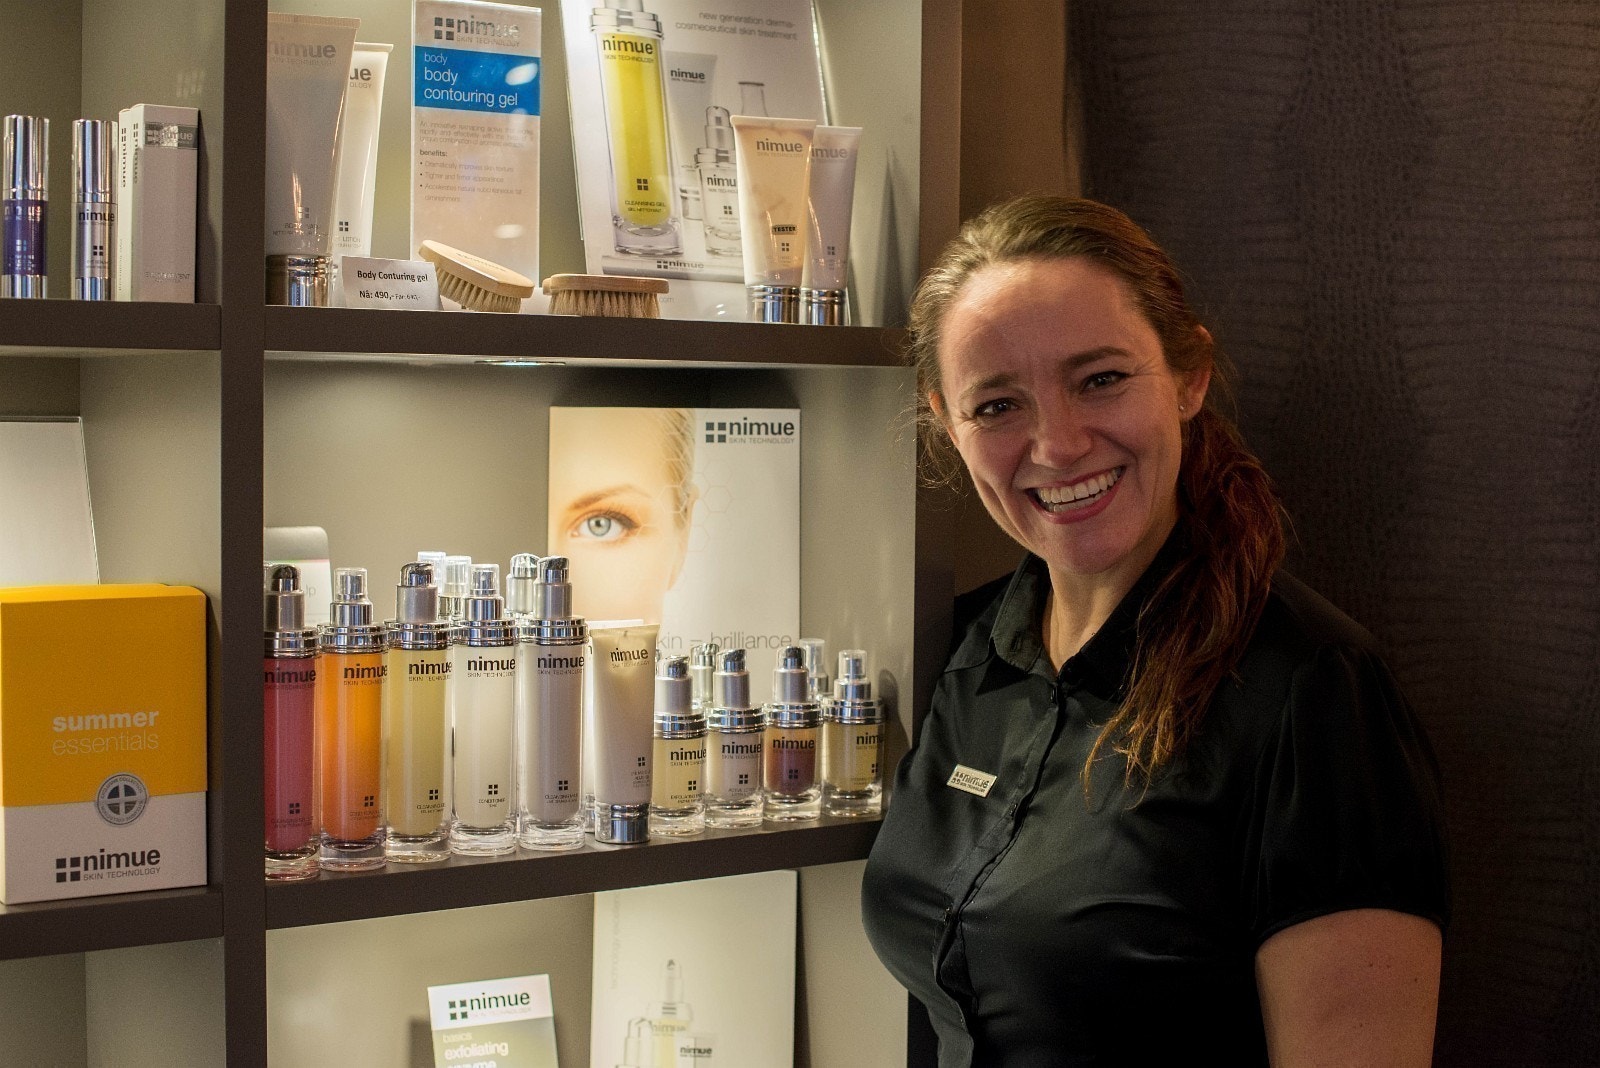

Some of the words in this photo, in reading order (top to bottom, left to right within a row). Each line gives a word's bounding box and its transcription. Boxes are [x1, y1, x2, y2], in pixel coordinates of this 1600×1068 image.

[457, 15, 519, 38] nimue
[719, 14, 764, 25] generation
[602, 35, 654, 54] nimue
[424, 52, 448, 66] body
[424, 66, 459, 85] body
[670, 68, 706, 80] nimue
[424, 87, 495, 107] contouring
[498, 92, 518, 108] gel
[420, 149, 448, 157] benefits:
[756, 138, 803, 153] nimue
[811, 144, 849, 159] imue
[706, 174, 737, 187] nimu
[79, 209, 115, 222] nimue
[669, 259, 704, 269] nimue
[357, 270, 376, 280] Body
[378, 271, 415, 282] Conturing
[417, 274, 428, 282] gel
[359, 290, 373, 299] Nå:
[729, 416, 795, 436] nimue
[710, 631, 792, 650] brilliance
[538, 653, 585, 668] nimue
[610, 648, 649, 662] nimue
[408, 660, 452, 675] nimue
[467, 656, 516, 670] nimue
[264, 667, 317, 684] nimue
[344, 663, 388, 679] nimue
[53, 711, 159, 733] summer
[52, 729, 159, 755] essentials
[722, 741, 761, 754] nimue
[773, 736, 815, 749] nimue
[670, 747, 707, 760] nimue
[84, 848, 160, 871] nimue
[84, 872, 103, 881] SKIN
[107, 867, 160, 879] TECHNOLOGY
[470, 992, 530, 1010] nimue
[445, 1041, 509, 1060] exfoliating
[680, 1044, 713, 1054] nimue
